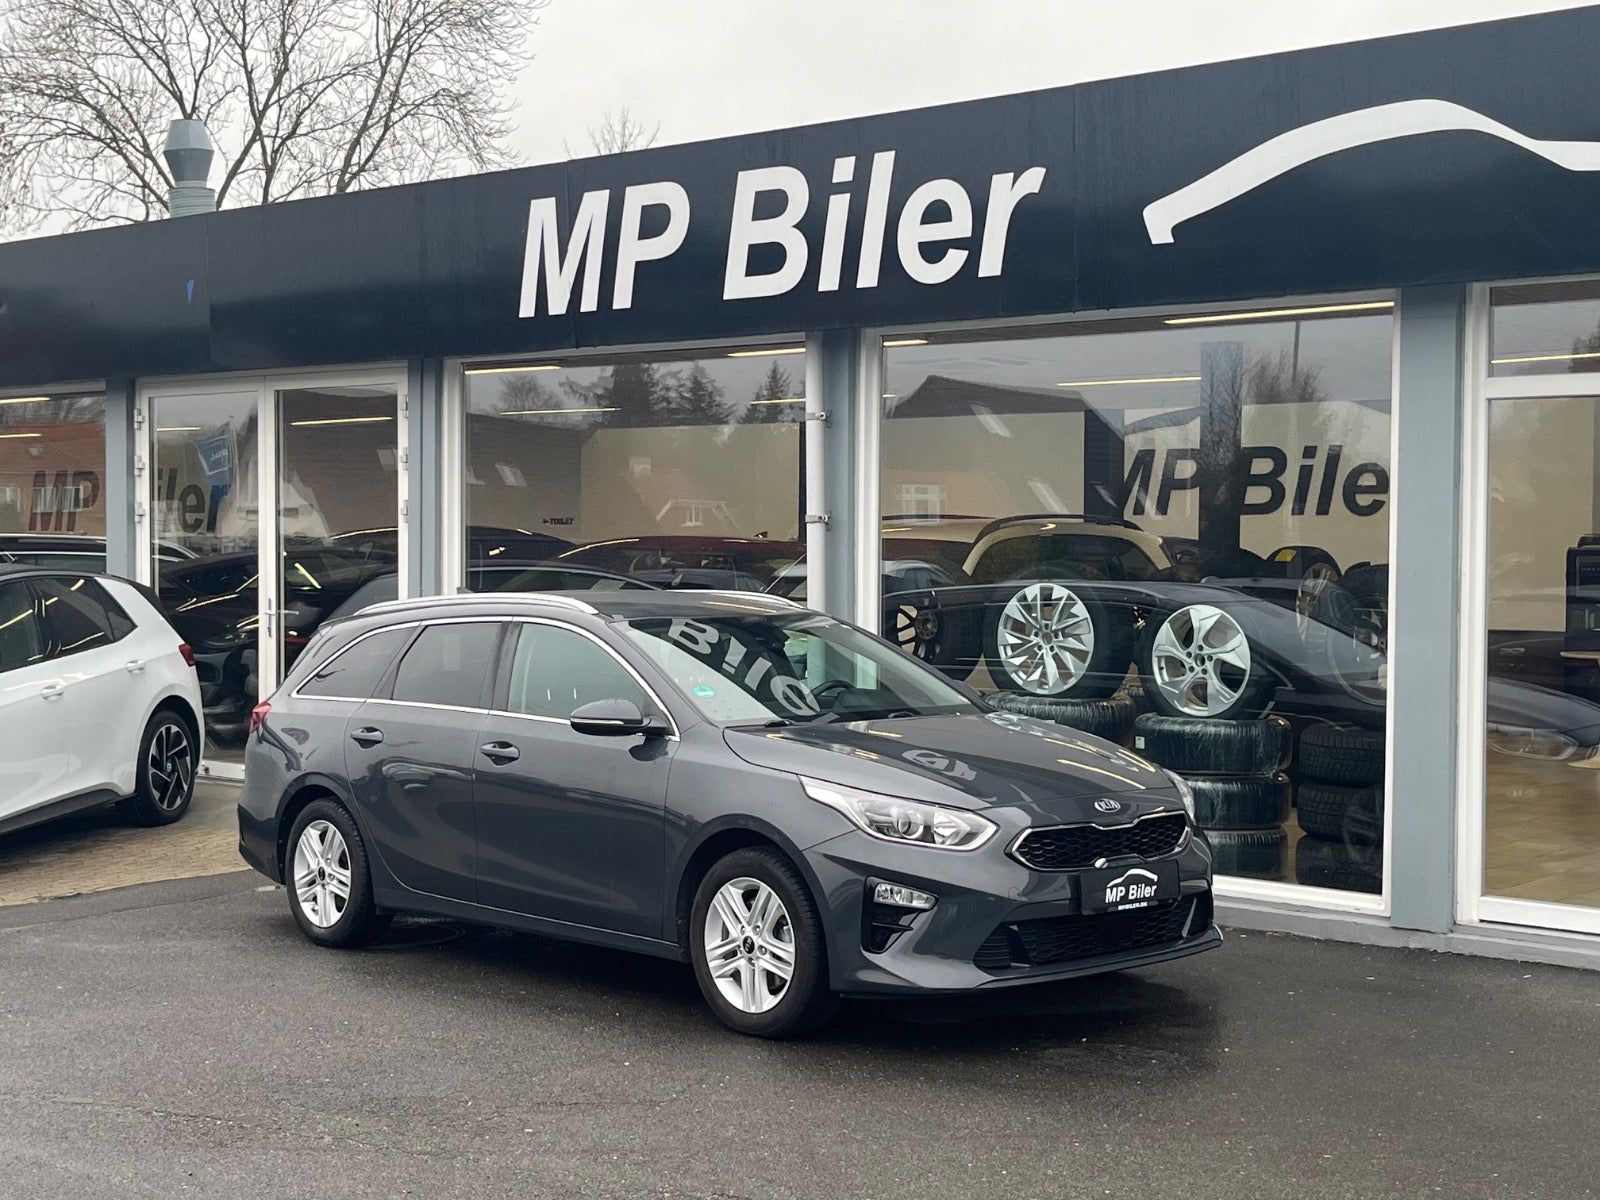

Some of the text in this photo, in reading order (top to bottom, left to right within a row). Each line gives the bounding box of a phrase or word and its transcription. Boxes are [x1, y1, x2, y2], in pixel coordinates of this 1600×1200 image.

[518, 150, 1048, 319] MP Biler
[28, 470, 100, 532] MP
[1237, 444, 1390, 517] Bile
[550, 517, 574, 525] TOILET
[1105, 883, 1158, 903] MP Biler
